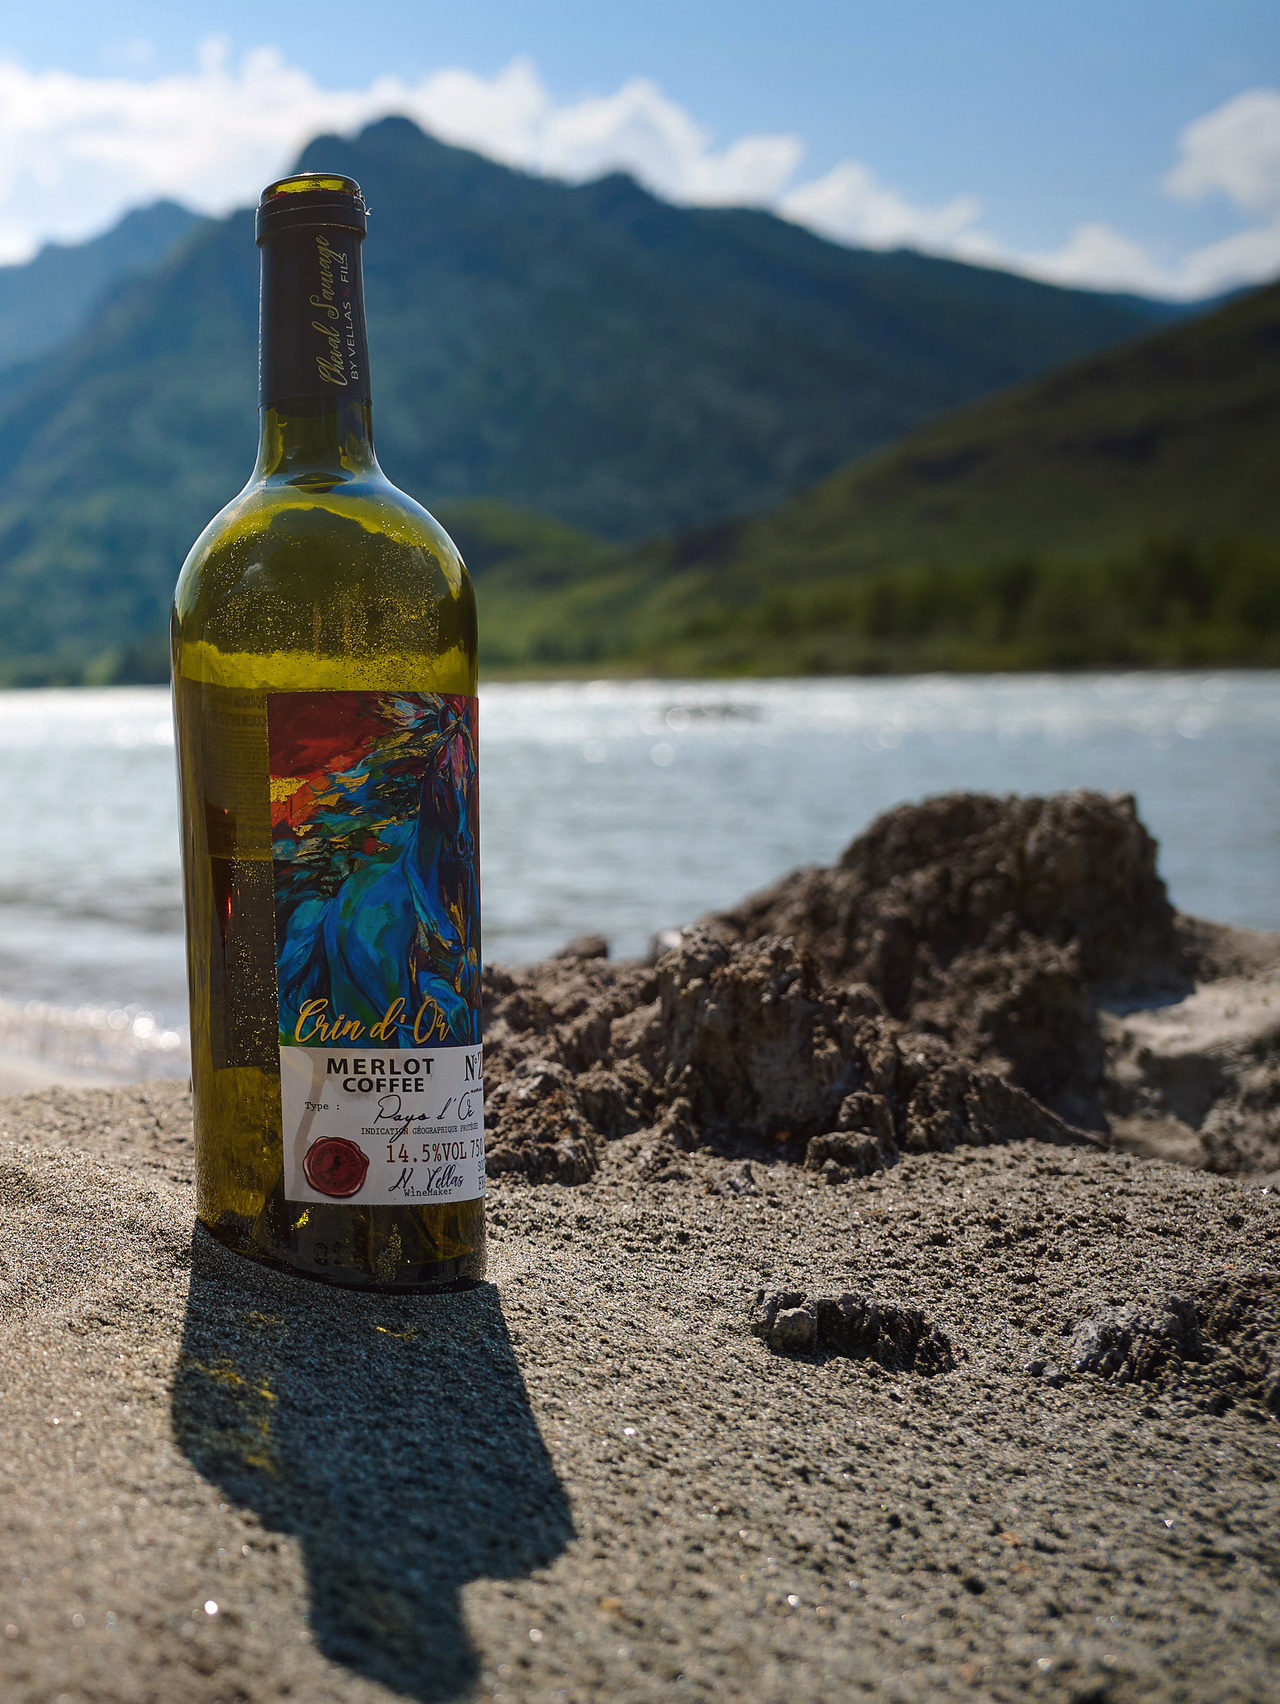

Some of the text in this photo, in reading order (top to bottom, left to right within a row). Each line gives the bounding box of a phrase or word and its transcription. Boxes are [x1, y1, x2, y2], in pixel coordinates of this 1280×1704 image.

[339, 252, 349, 283] FILS
[310, 235, 348, 386] Cheval Sauvage
[343, 301, 356, 358] VELLAS
[349, 361, 359, 380] BY
[294, 998, 366, 1043] Crin
[326, 1057, 435, 1075] MERLOT
[342, 1077, 425, 1093] COFFEE
[304, 1101, 329, 1111] Type
[373, 1094, 430, 1143] Pays
[426, 1164, 464, 1192] Vellas
[403, 1188, 453, 1197] WineMaker
